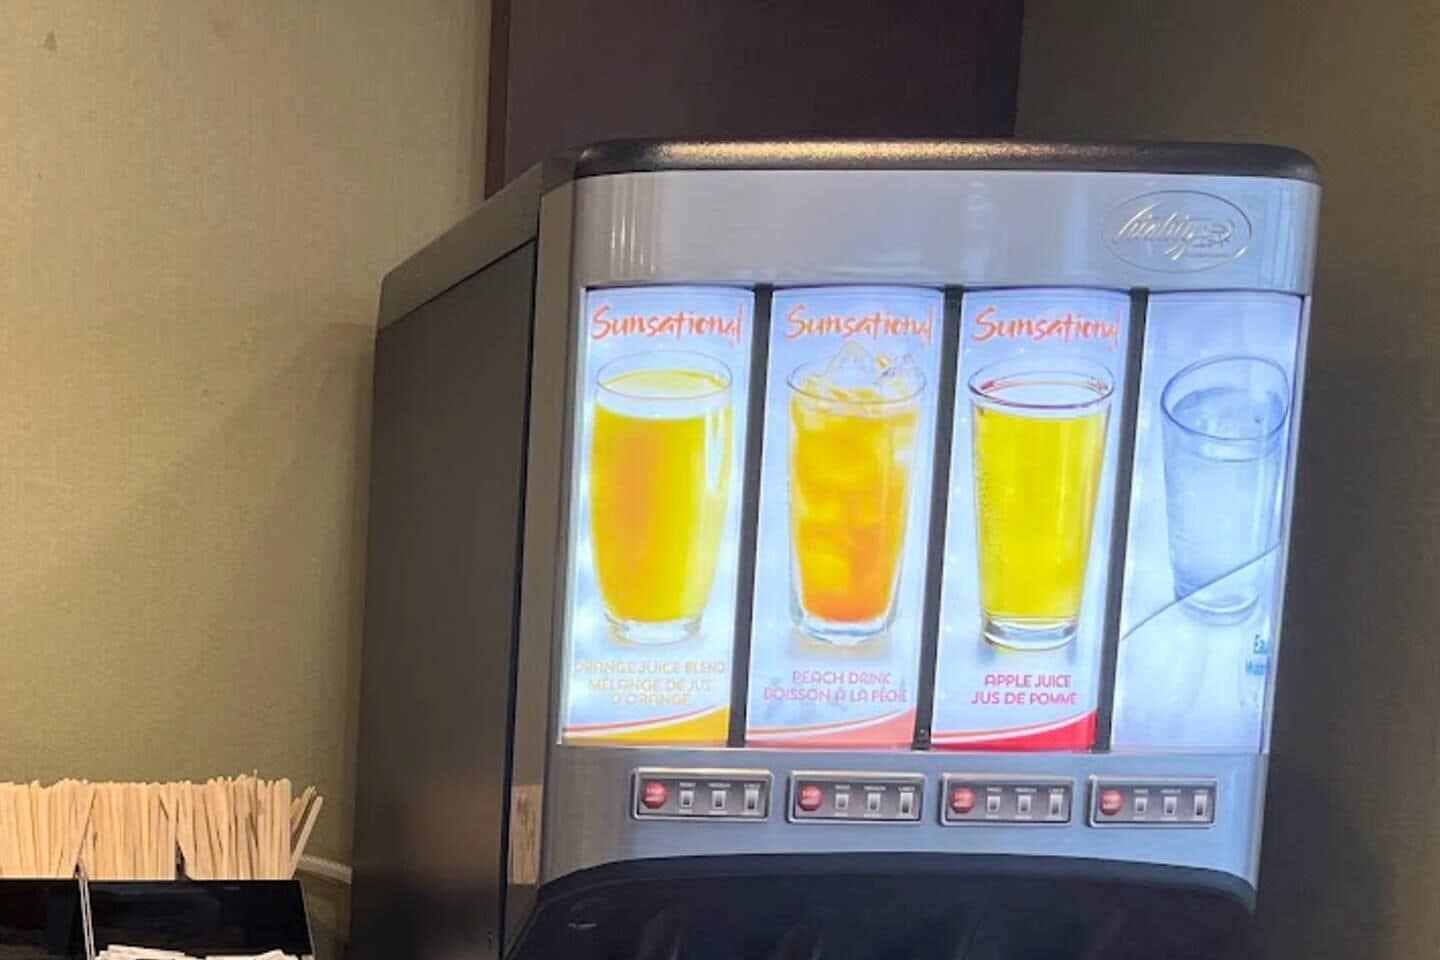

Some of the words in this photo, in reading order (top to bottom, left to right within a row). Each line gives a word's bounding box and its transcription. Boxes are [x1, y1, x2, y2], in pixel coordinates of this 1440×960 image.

[591, 303, 744, 346] Sunsational
[784, 303, 934, 345] Sunsational
[971, 305, 1121, 350] Sunsational
[971, 692, 1001, 705] JUS
[1004, 692, 1025, 705] DE
[1029, 692, 1078, 706] POMME
[984, 674, 1033, 687] APPLE
[1034, 674, 1072, 688] JUICE
